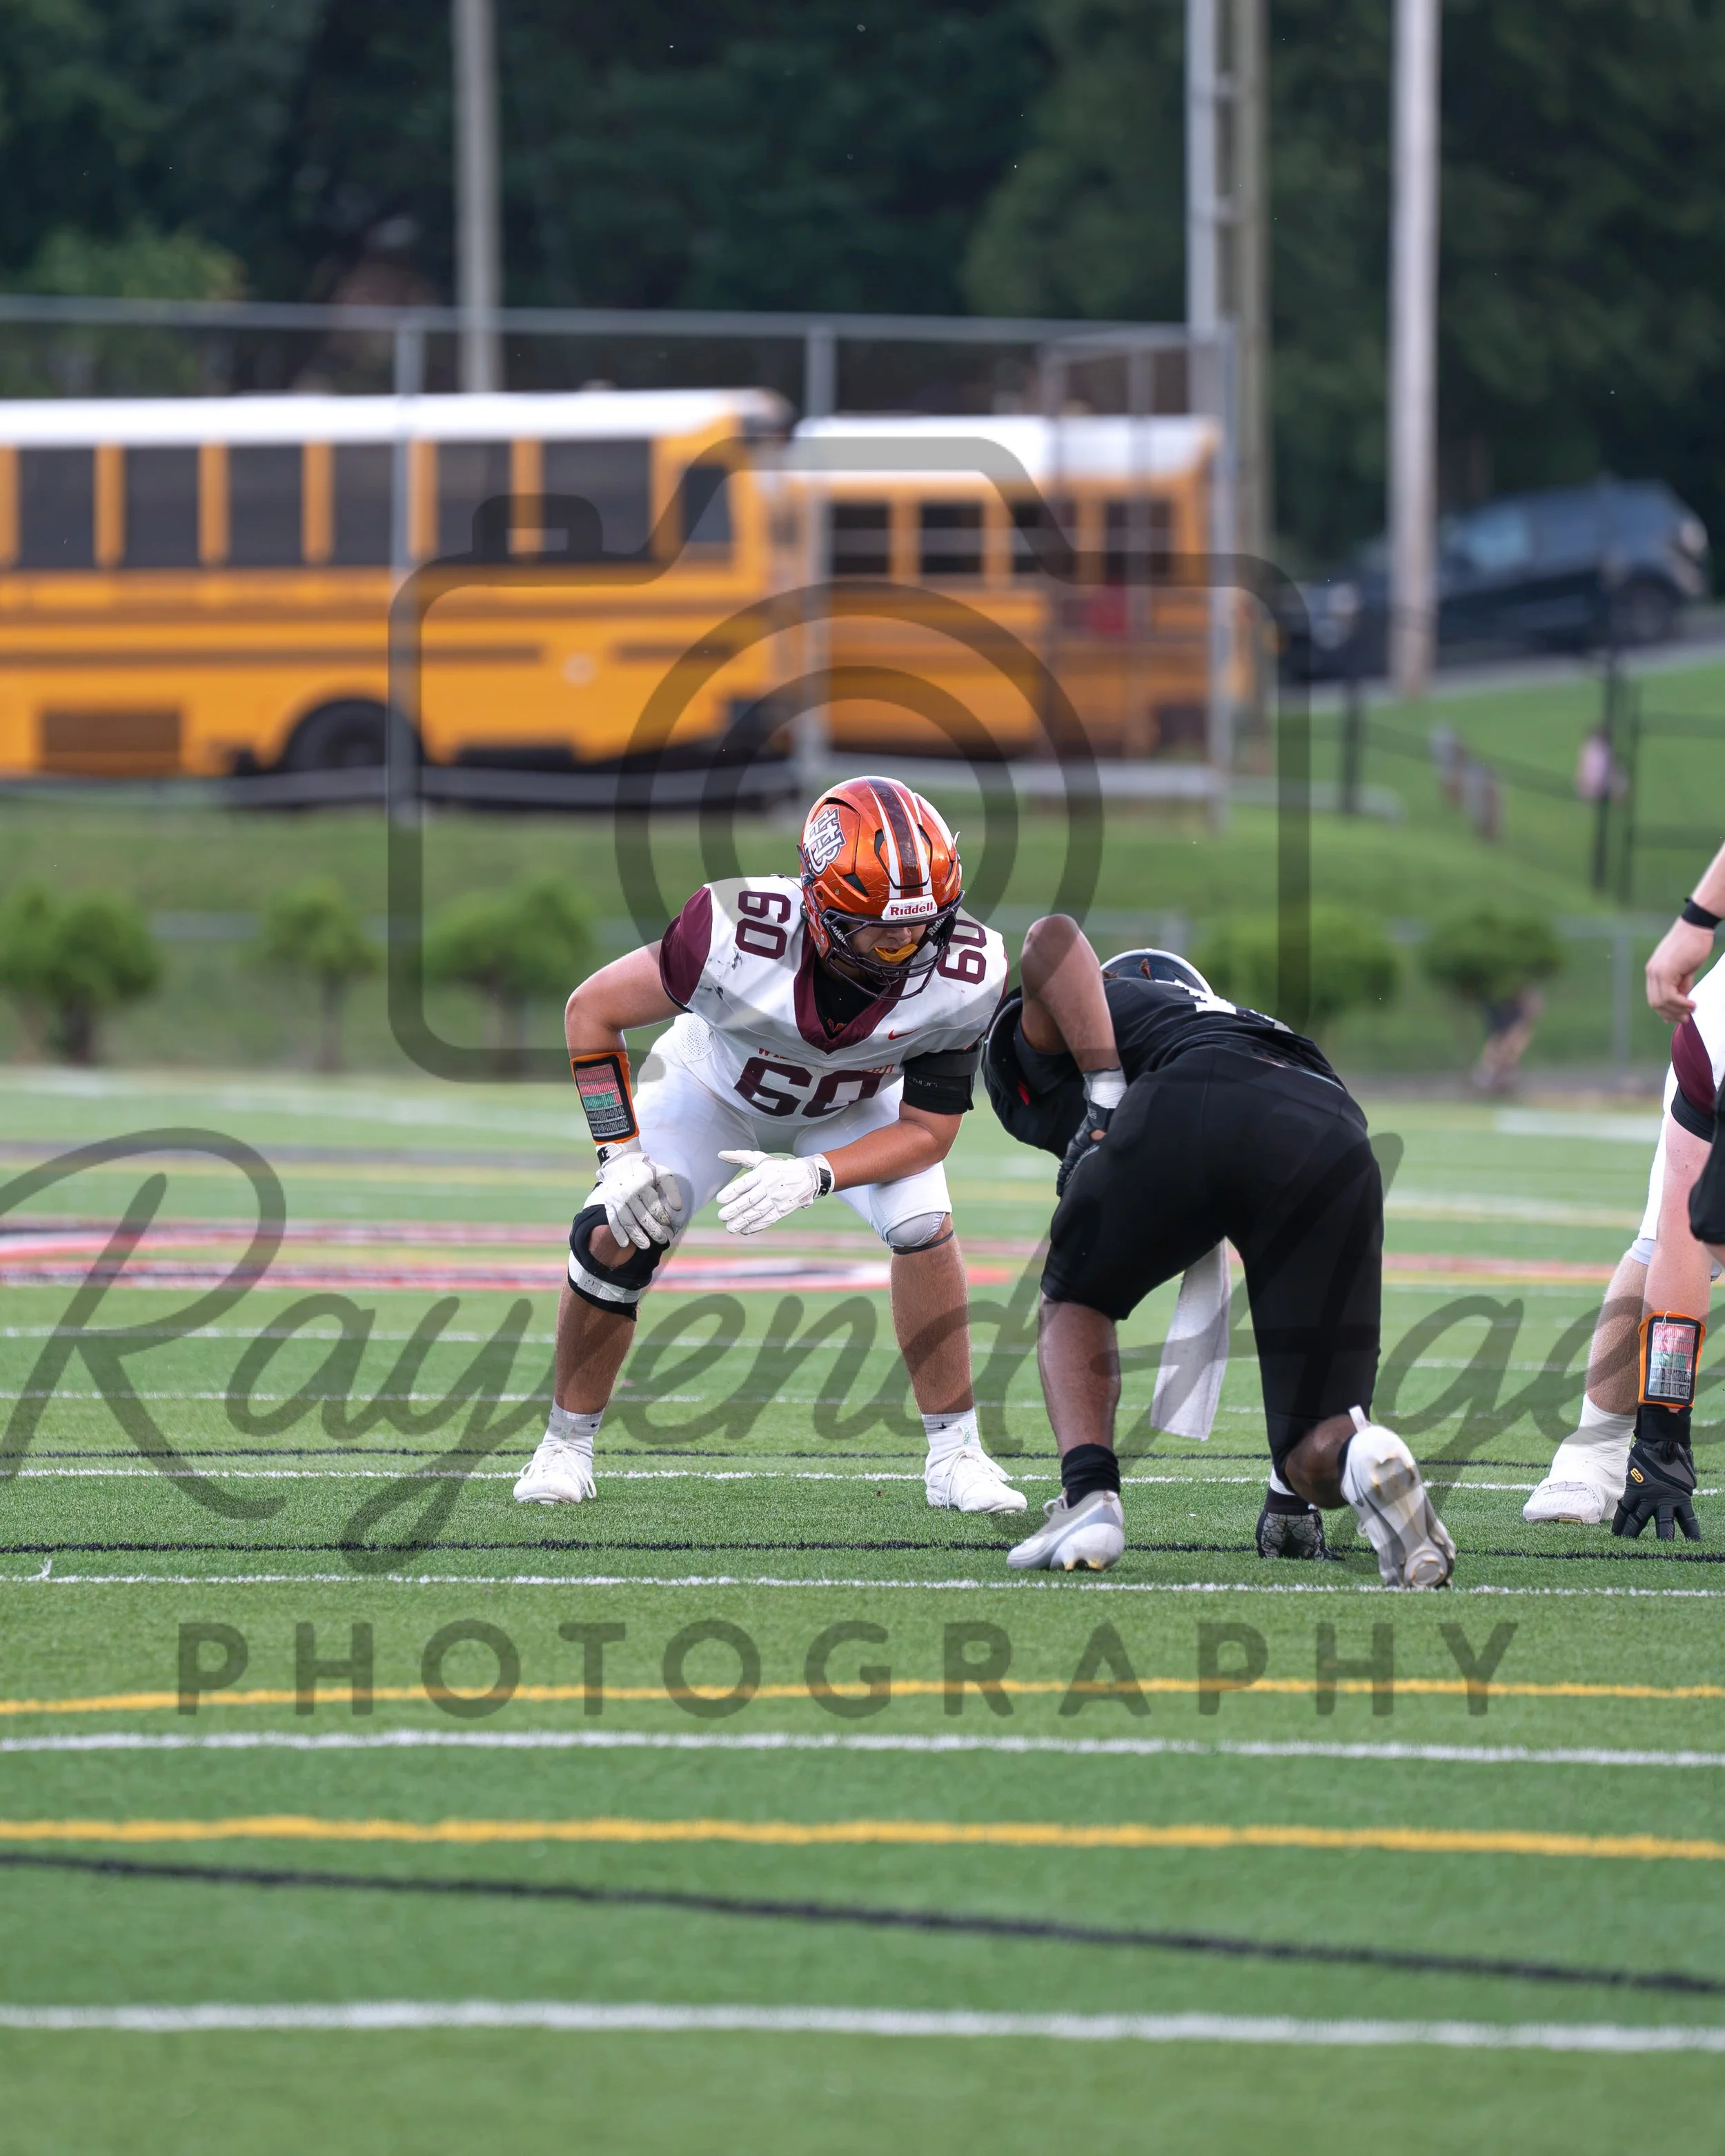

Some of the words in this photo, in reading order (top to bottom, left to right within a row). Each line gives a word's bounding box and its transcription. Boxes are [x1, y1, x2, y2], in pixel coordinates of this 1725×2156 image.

[735, 890, 791, 960] 60
[890, 902, 934, 916] Riddell
[936, 919, 987, 985] 60
[733, 1056, 885, 1118] 60
